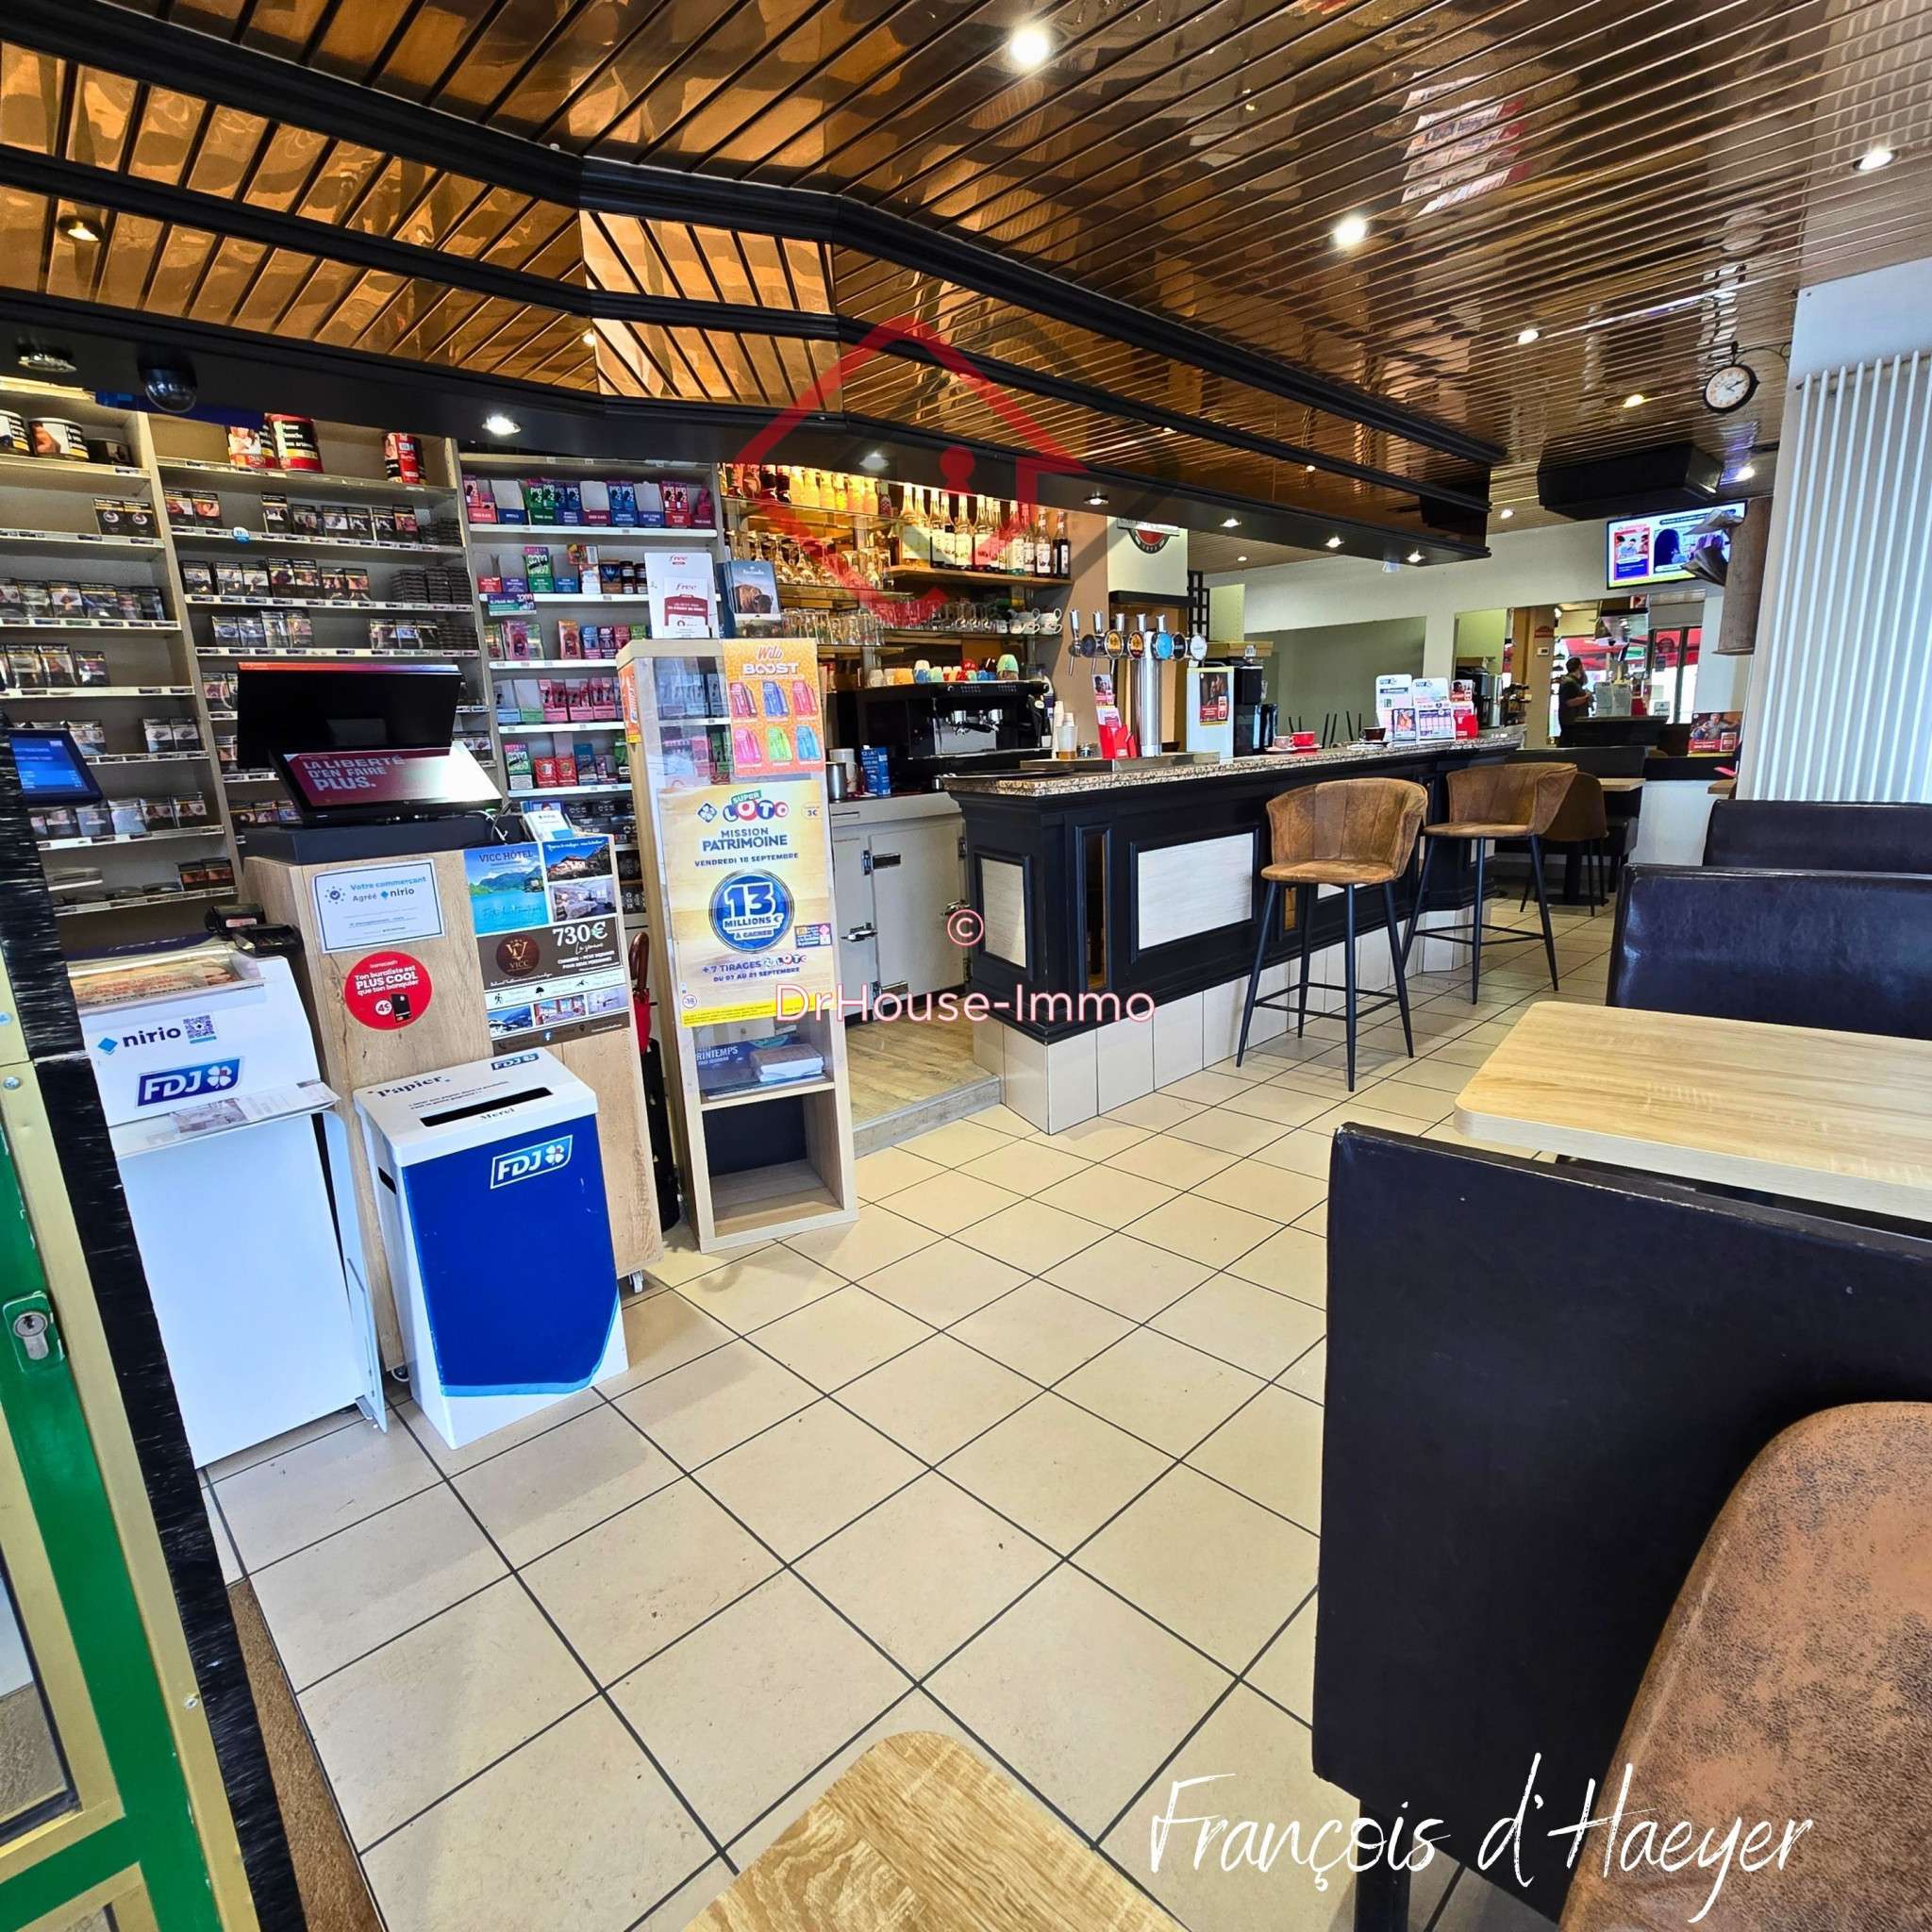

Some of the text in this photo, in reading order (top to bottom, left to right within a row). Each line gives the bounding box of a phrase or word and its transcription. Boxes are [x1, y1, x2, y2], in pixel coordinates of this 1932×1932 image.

[675, 582, 696, 591] free
[743, 662, 799, 675] BOOST
[304, 755, 406, 770] LA LIBERTÉ
[308, 766, 387, 778] D'EN FAIRE
[313, 776, 376, 791] PLUS.
[732, 791, 761, 803] SUPER
[723, 799, 790, 822] LOTO
[721, 827, 769, 838] MISSION
[702, 835, 788, 852] PATRIMOINE
[479, 850, 533, 863] VICC HÔTEL
[694, 857, 738, 867] VENDREDI
[750, 853, 799, 863] SEPTEMBRE
[350, 876, 427, 891] Votre commerçant
[391, 888, 415, 897] nirio
[725, 884, 774, 918] 13
[724, 916, 772, 928] MILLIONS
[553, 921, 608, 947] 730€
[370, 968, 404, 978] buraliste
[720, 960, 761, 973] TIRAGES
[758, 967, 800, 977] SEPTEMBRE
[356, 972, 419, 991] PLUS COOL
[357, 989, 373, 997] que
[386, 980, 420, 991] banquier
[123, 1026, 181, 1047] nirio
[696, 1046, 739, 1061] RINTEMPS
[493, 1056, 523, 1071] FDJ
[144, 1071, 201, 1101] FDJ
[497, 1151, 541, 1181] FDJ
